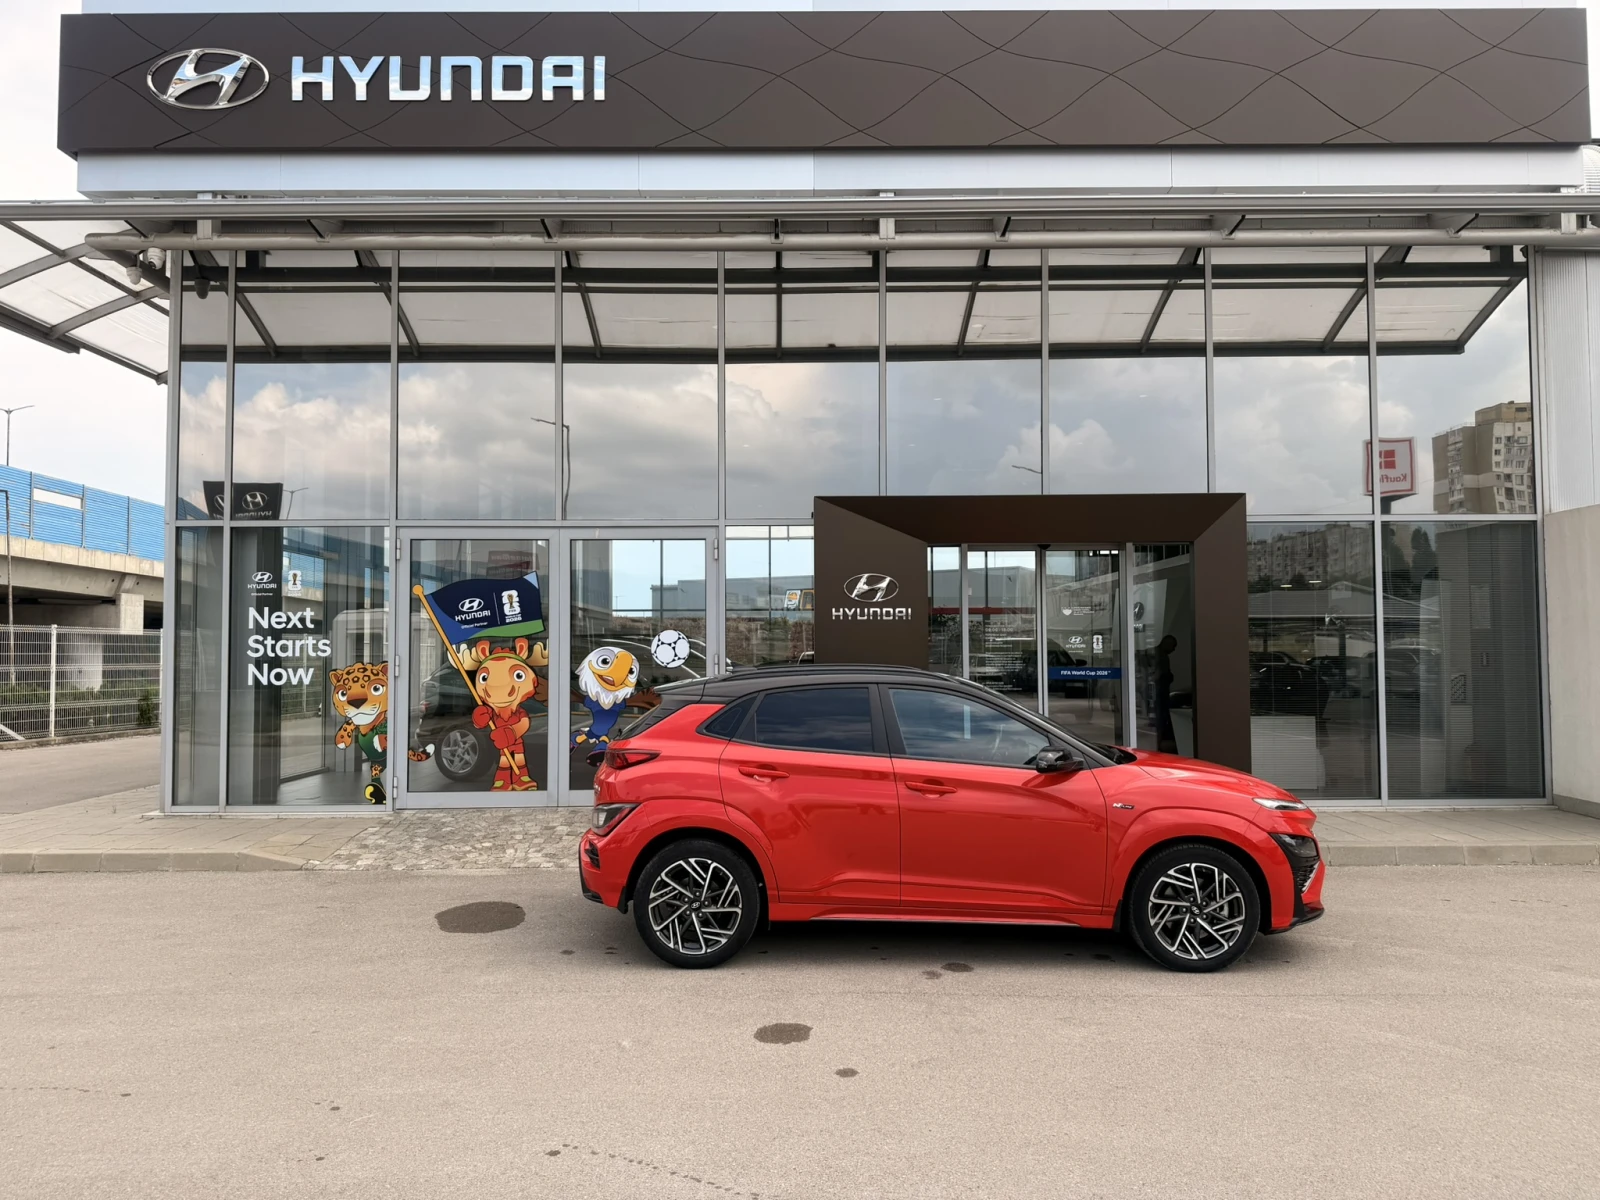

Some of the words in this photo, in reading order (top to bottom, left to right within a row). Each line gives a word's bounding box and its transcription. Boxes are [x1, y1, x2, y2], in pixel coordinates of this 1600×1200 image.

[291, 55, 606, 102] HYUNDAI
[248, 606, 314, 629] Next
[455, 609, 491, 622] HYUNDAI
[832, 607, 912, 620] HYUNDAI
[247, 634, 332, 658] Starts
[247, 663, 314, 686] Now
